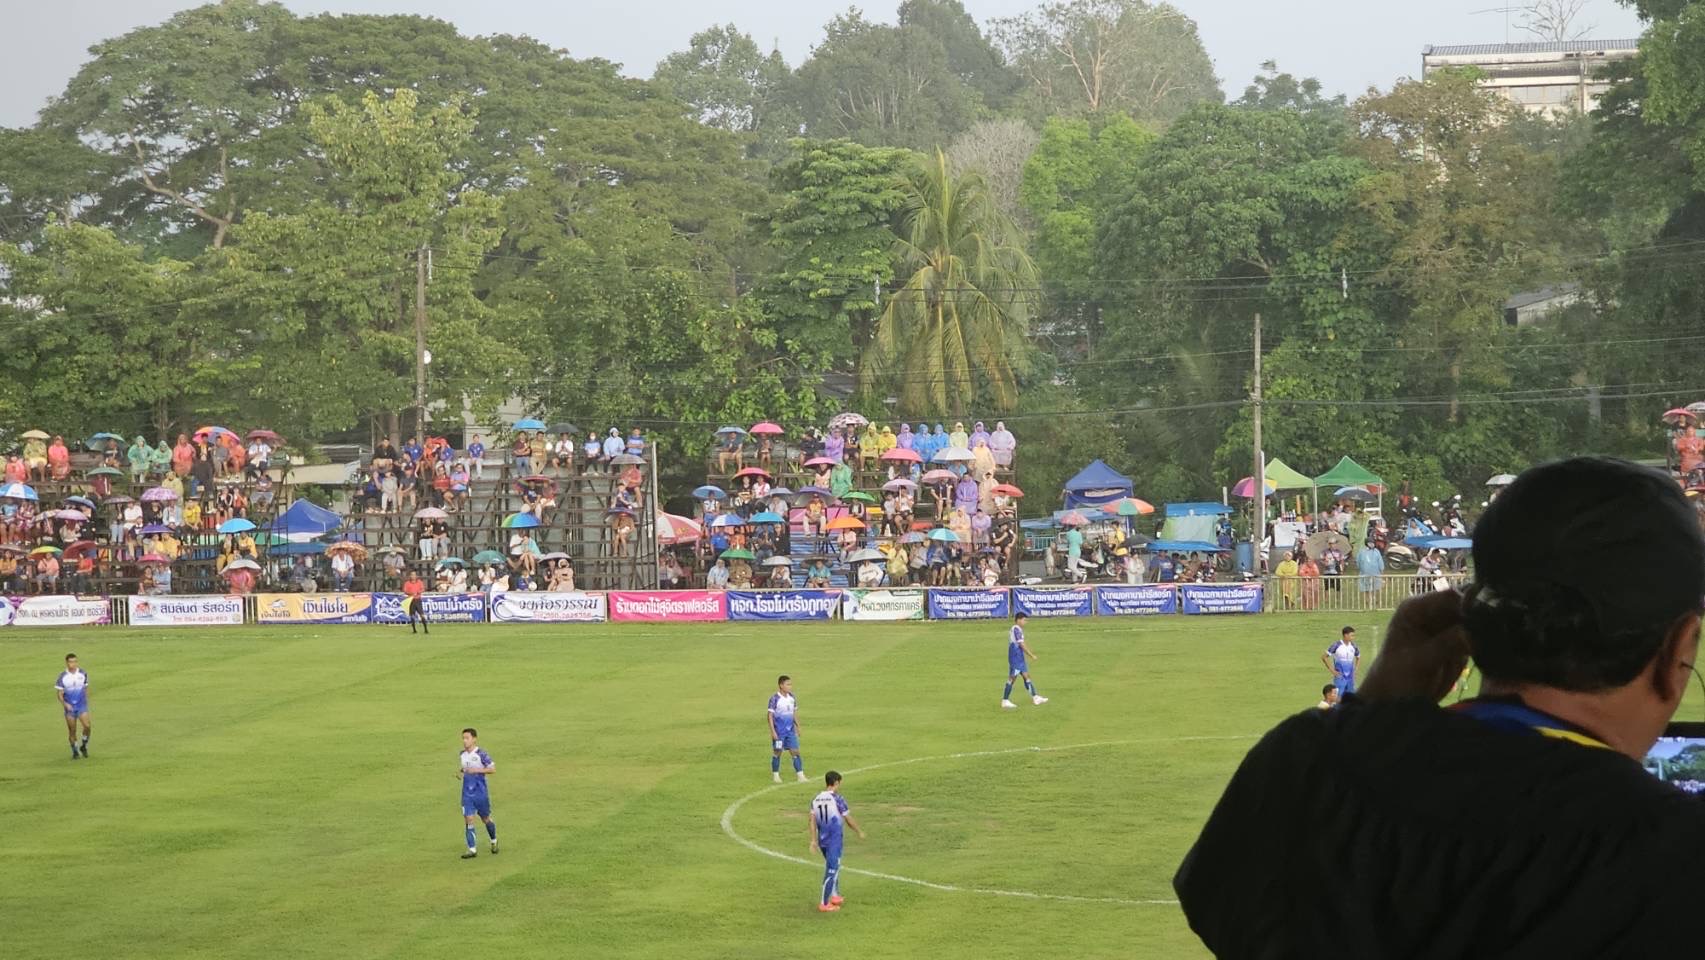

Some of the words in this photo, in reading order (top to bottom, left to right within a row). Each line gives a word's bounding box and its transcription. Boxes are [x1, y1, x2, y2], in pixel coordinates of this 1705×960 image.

[303, 597, 348, 613] เงินไชโย
[817, 804, 828, 824] 11
